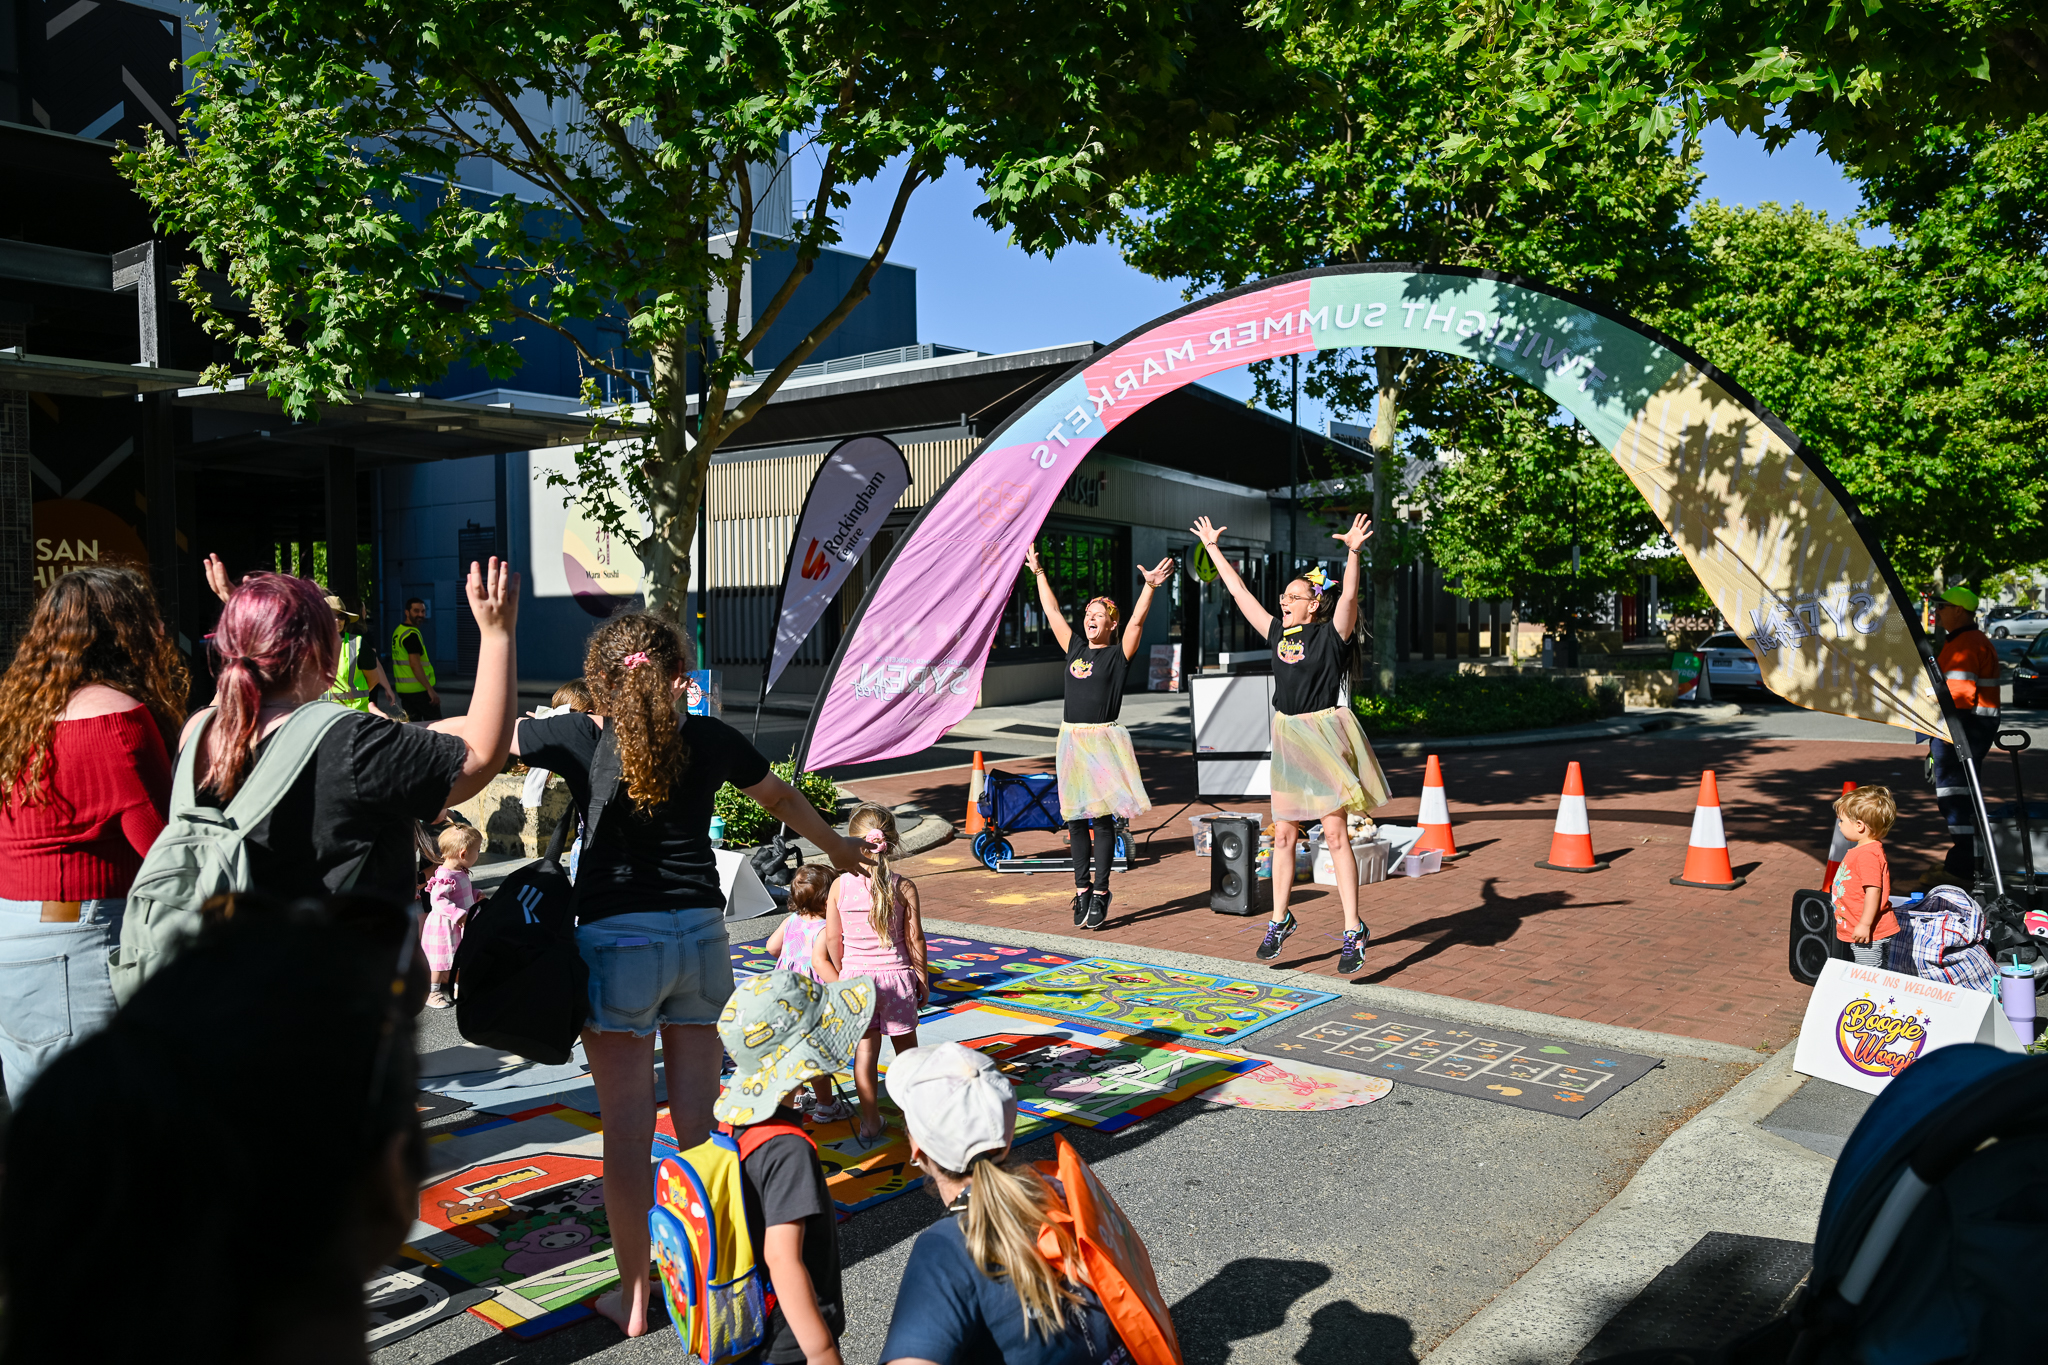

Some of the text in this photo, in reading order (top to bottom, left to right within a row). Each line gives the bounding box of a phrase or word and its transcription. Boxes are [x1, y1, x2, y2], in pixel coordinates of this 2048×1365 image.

[823, 471, 886, 556] Rockingham
[36, 538, 99, 561] SAN
[836, 527, 864, 563] Centre
[1850, 968, 1956, 1002] WALK INS WELCOME
[1843, 999, 1925, 1043] Boogie
[1853, 1031, 1917, 1077] Woogi
